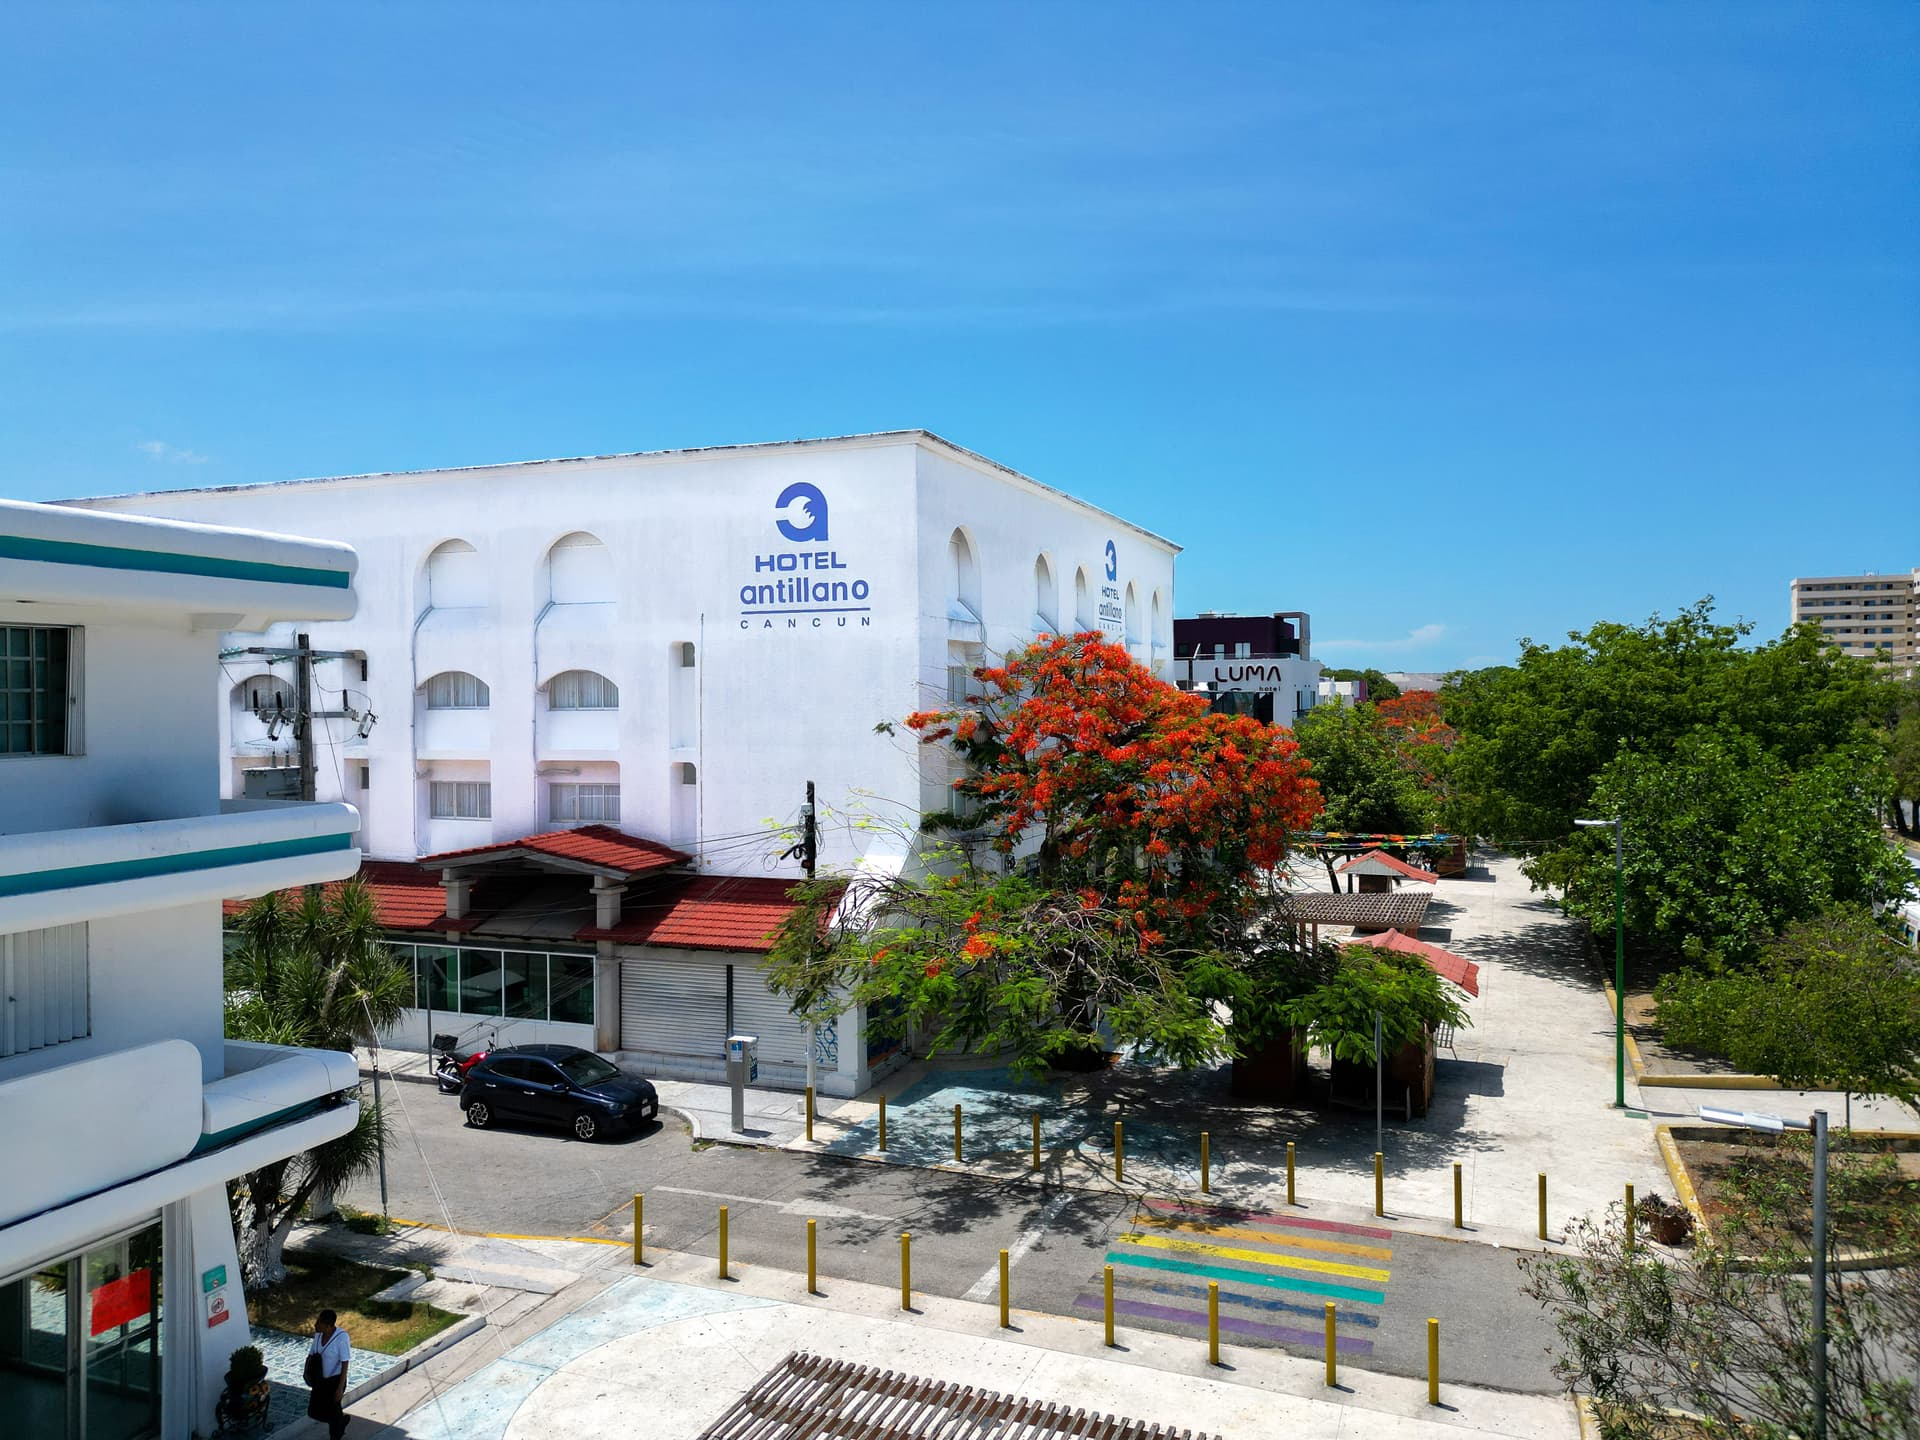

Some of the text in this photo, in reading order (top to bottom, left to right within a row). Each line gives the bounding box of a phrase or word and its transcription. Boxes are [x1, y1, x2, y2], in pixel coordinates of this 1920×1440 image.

[755, 551, 847, 572] HOTEL
[740, 577, 869, 605] antillano
[1102, 586, 1120, 600] HOTEL
[1099, 602, 1122, 619] antillano
[740, 616, 870, 629] CANCUN
[1215, 665, 1282, 682] LUMA
